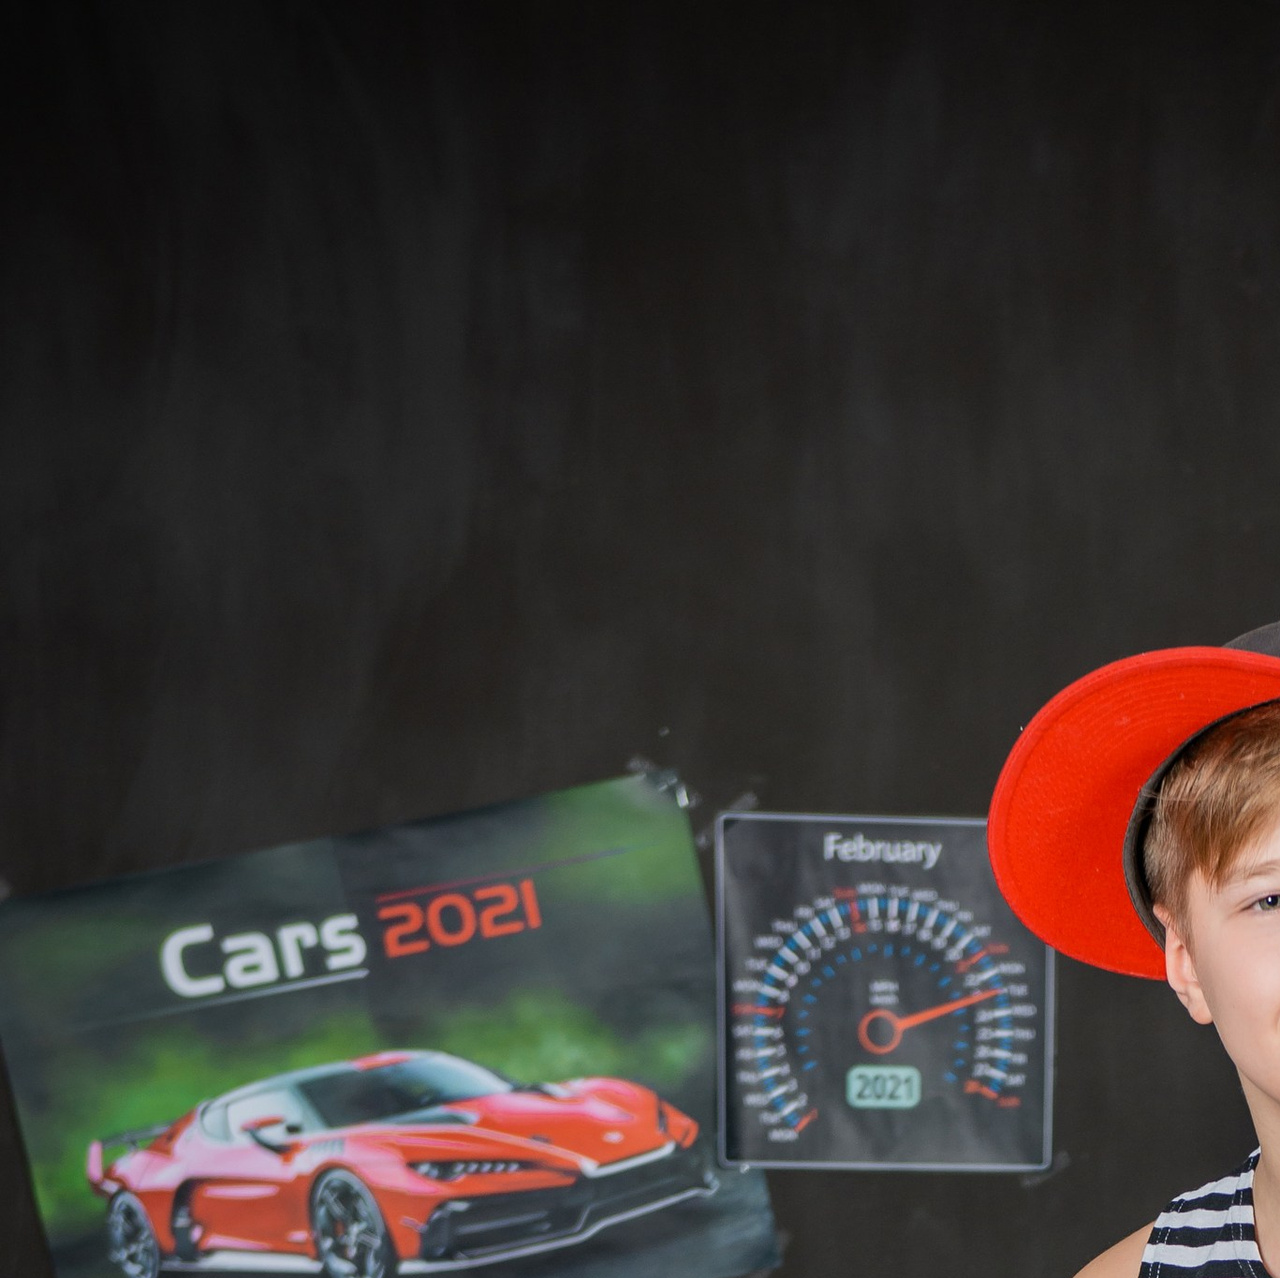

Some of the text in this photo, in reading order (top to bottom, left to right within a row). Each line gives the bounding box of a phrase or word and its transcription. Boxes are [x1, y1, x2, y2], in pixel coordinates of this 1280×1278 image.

[823, 832, 943, 869] February
[159, 879, 542, 998] Cars 2021
[855, 1074, 915, 1100] 2021
